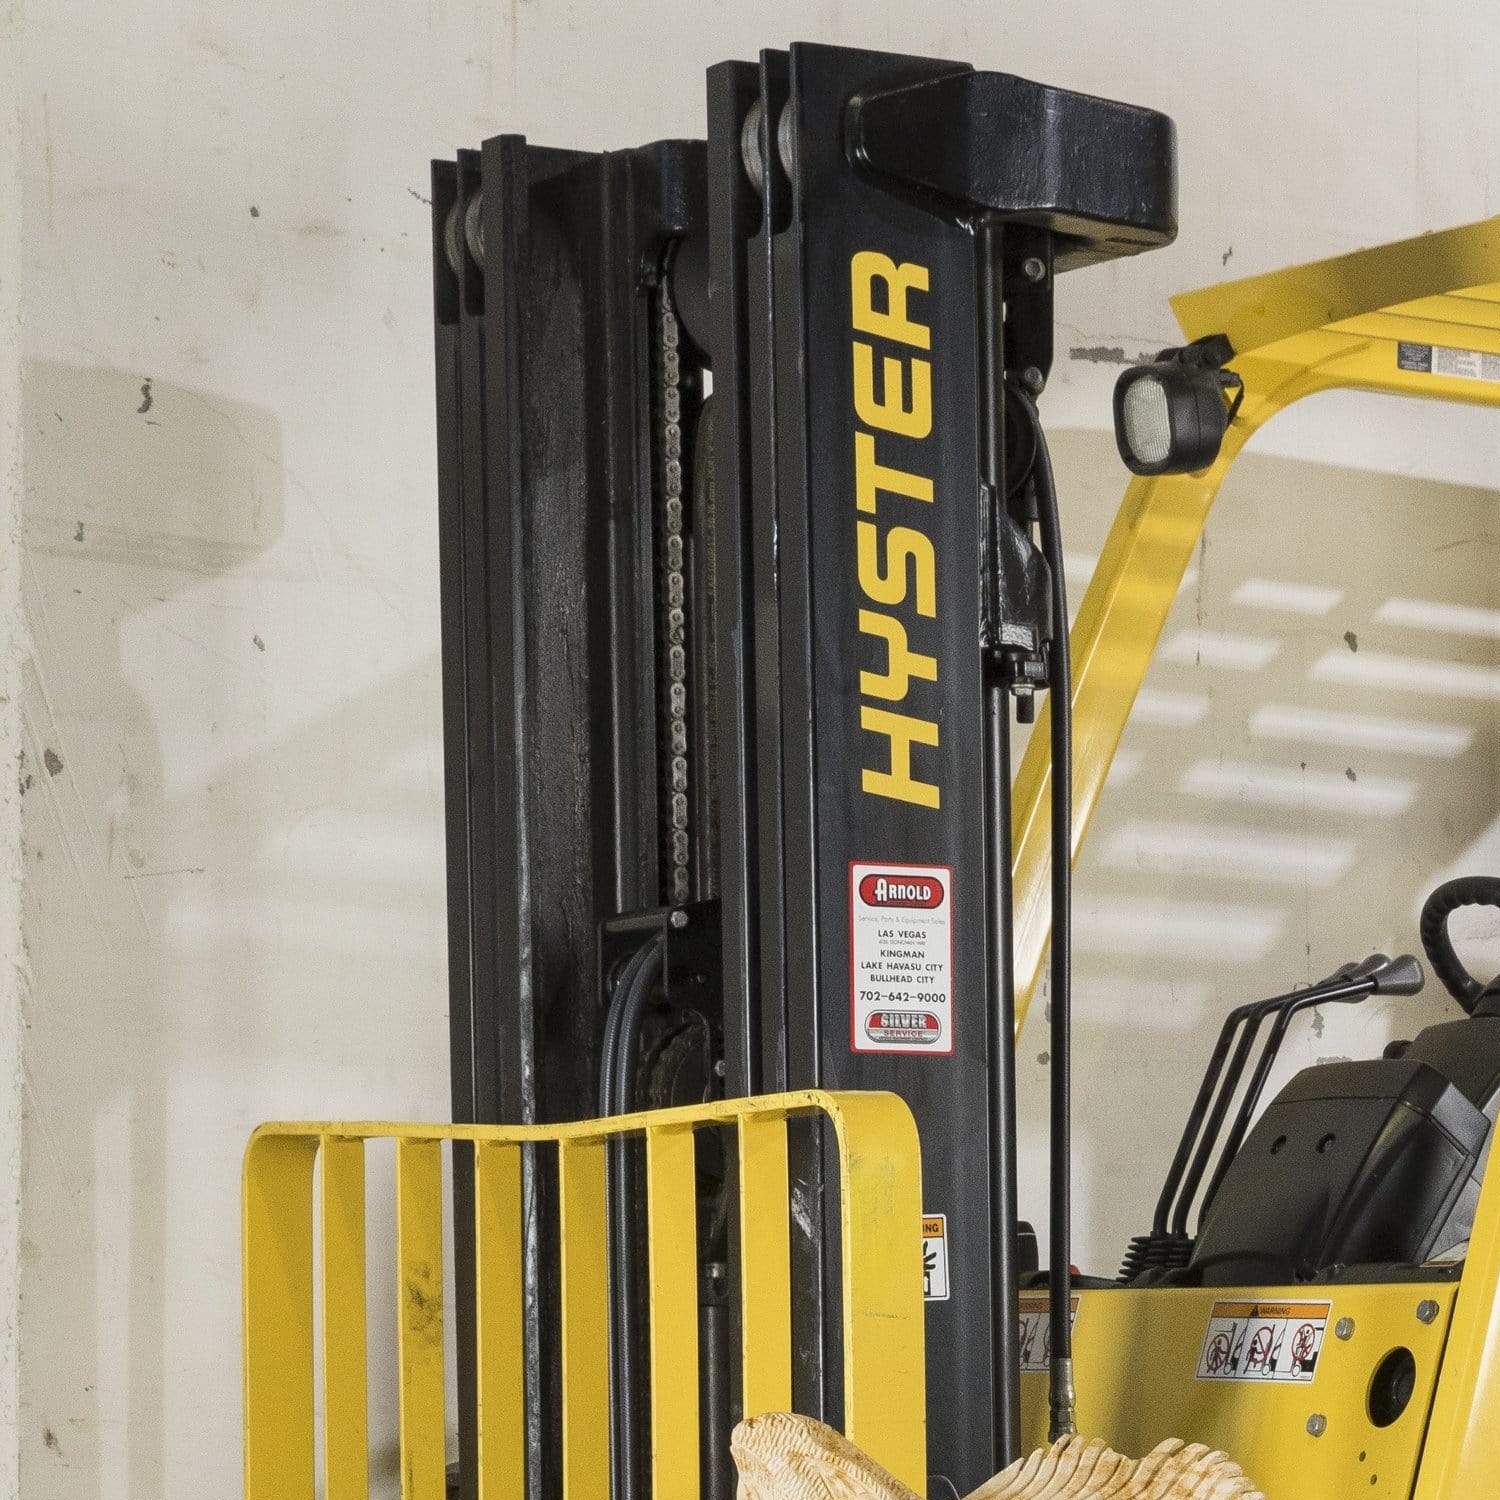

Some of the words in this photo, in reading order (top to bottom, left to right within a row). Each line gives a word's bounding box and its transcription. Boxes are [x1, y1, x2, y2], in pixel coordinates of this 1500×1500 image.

[851, 251, 940, 809] HYSTER
[878, 929, 894, 938] LAS
[897, 930, 927, 939] VEGAS
[880, 949, 925, 958] KINGMAN
[861, 961, 883, 970] LAKE
[886, 962, 922, 971] HAVASU
[925, 963, 944, 972] CITY
[870, 974, 913, 983] BULLHEAD
[916, 975, 935, 984] CITY
[859, 990, 946, 1003] 702-642-9000
[880, 1013, 928, 1029] SILVER
[883, 1029, 923, 1037] SERVICE
